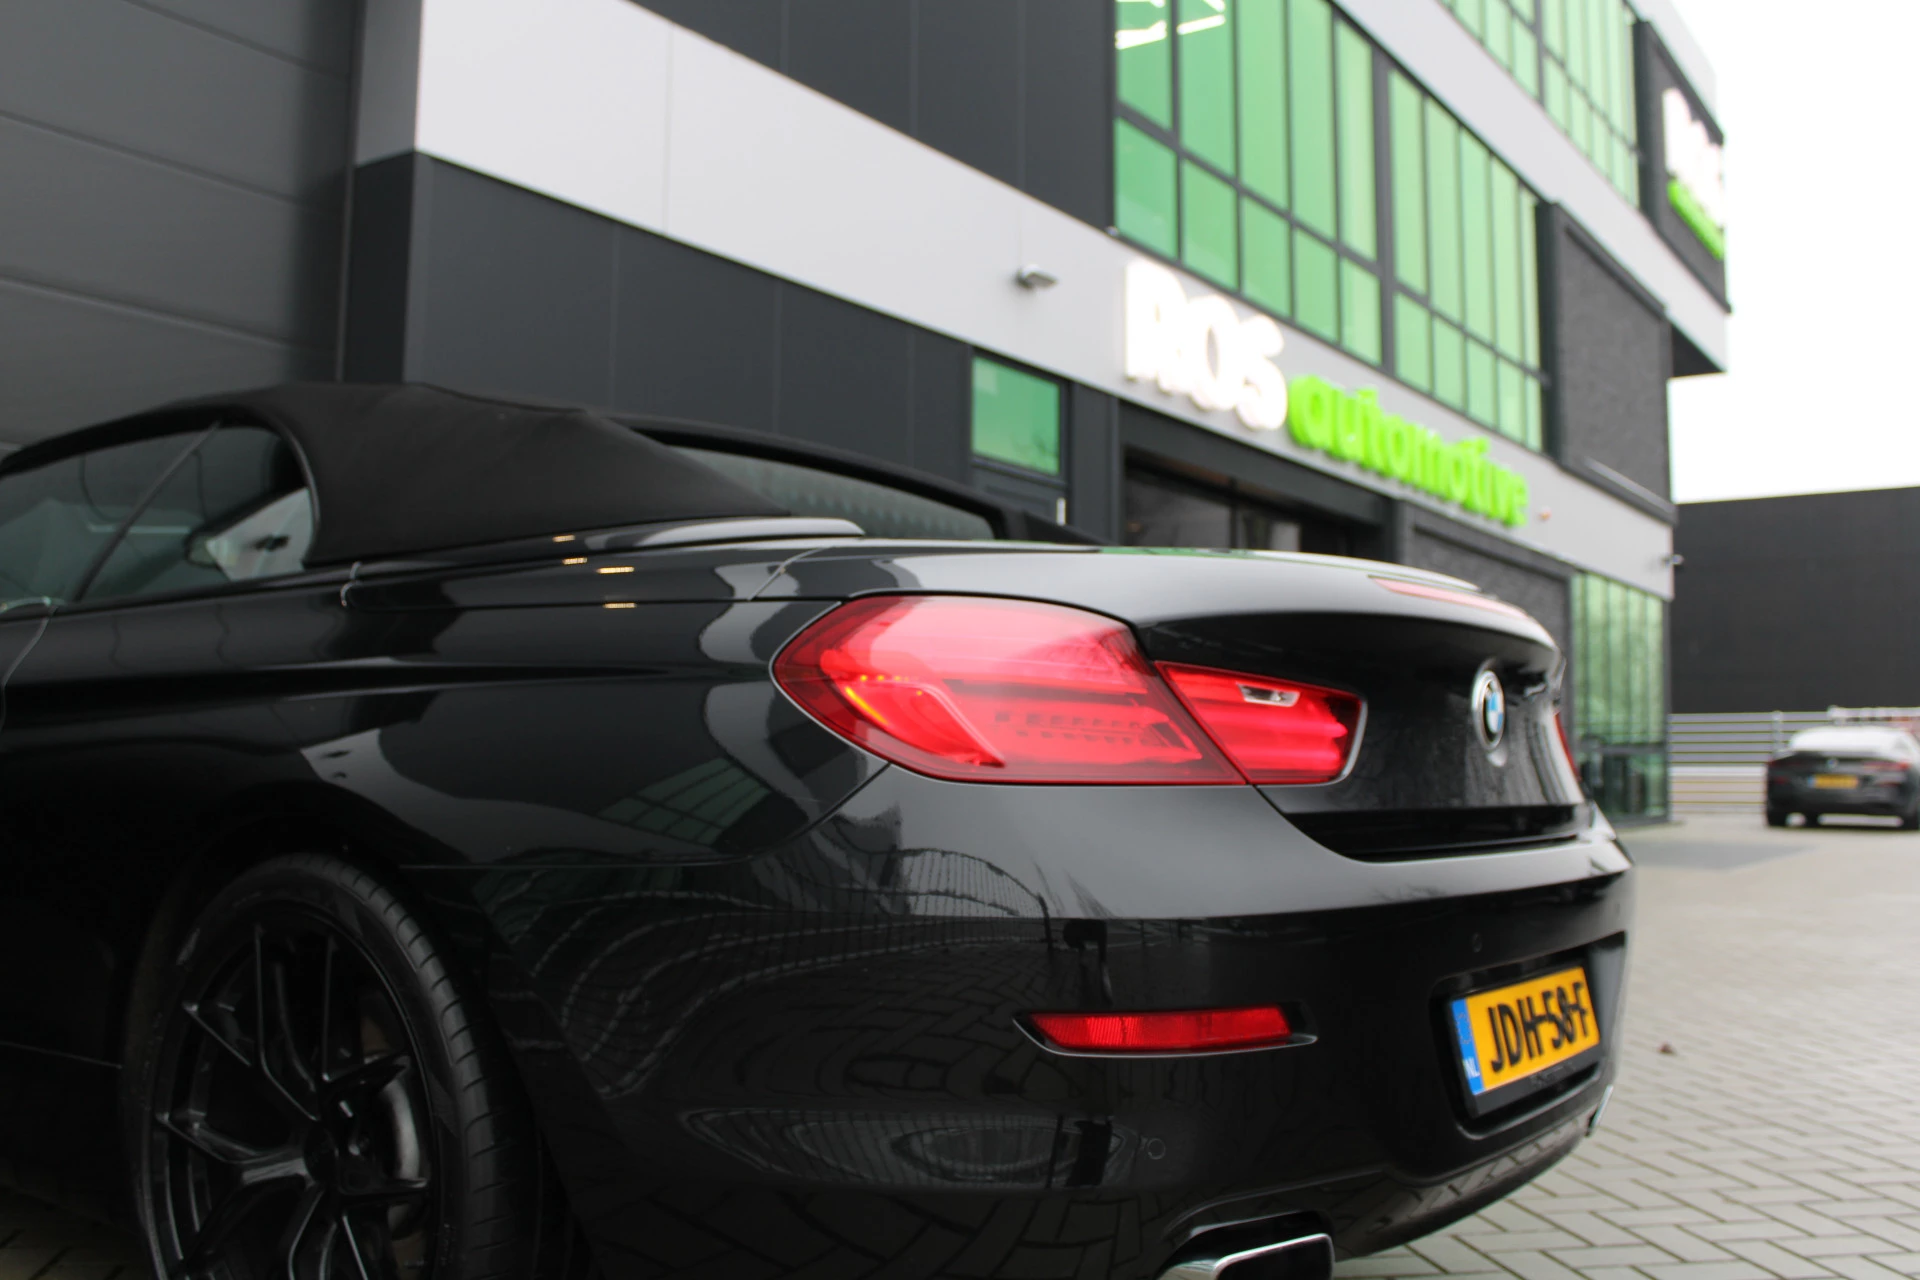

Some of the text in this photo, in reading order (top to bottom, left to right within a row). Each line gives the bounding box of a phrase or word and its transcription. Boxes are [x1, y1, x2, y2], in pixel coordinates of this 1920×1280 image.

[1126, 258, 1528, 527] ROS automotive
[1463, 1056, 1481, 1079] NL
